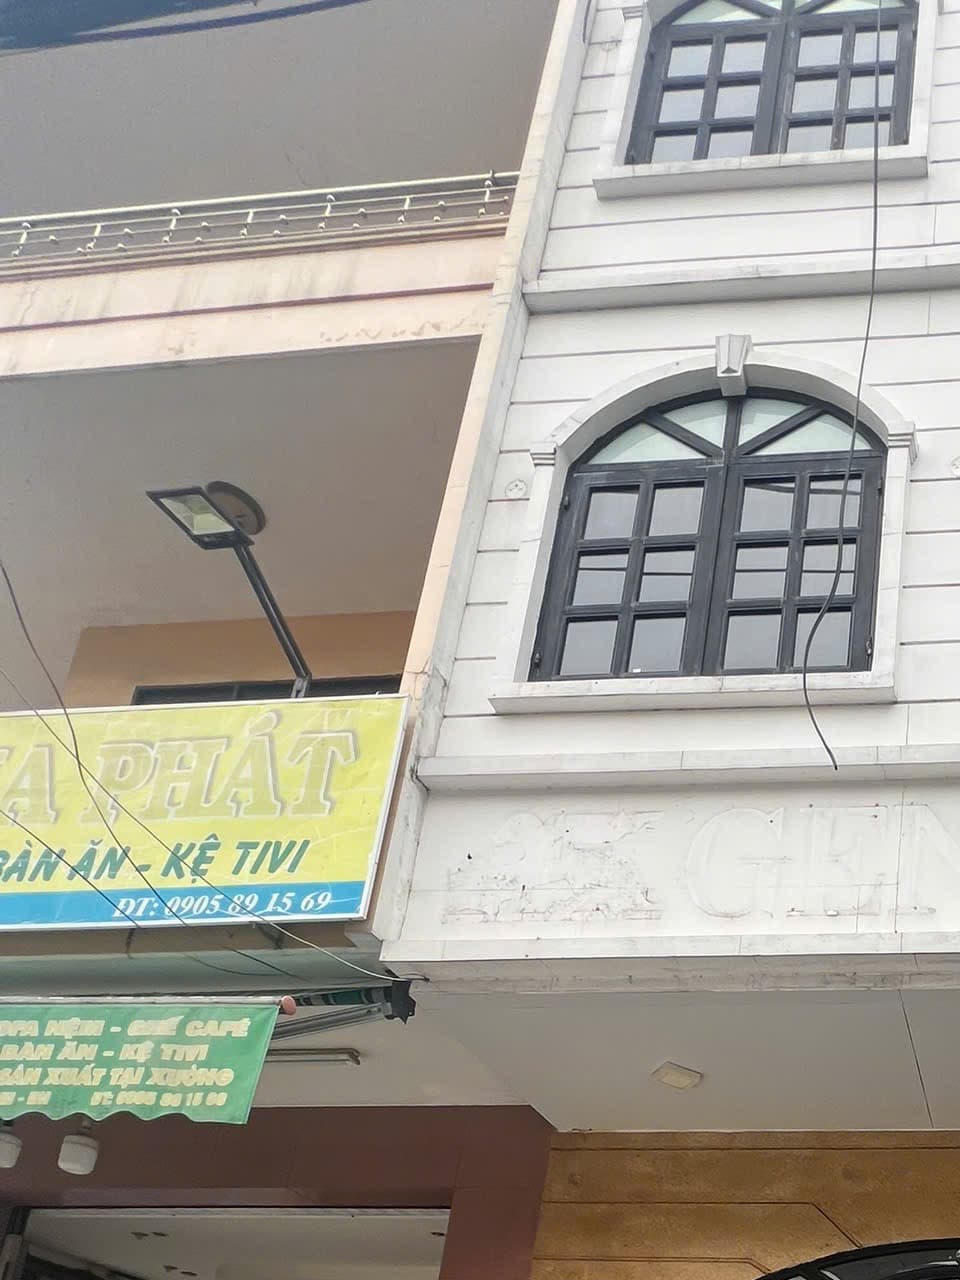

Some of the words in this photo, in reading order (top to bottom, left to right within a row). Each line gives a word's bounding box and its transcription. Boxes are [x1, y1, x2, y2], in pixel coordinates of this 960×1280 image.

[0, 742, 57, 827] A
[80, 711, 359, 824] PHÁT
[160, 833, 221, 884] KỆ
[231, 839, 312, 876] TIVI
[163, 895, 227, 917] 0905
[227, 893, 259, 914] 89
[264, 891, 294, 913] 15
[300, 891, 333, 912] 69
